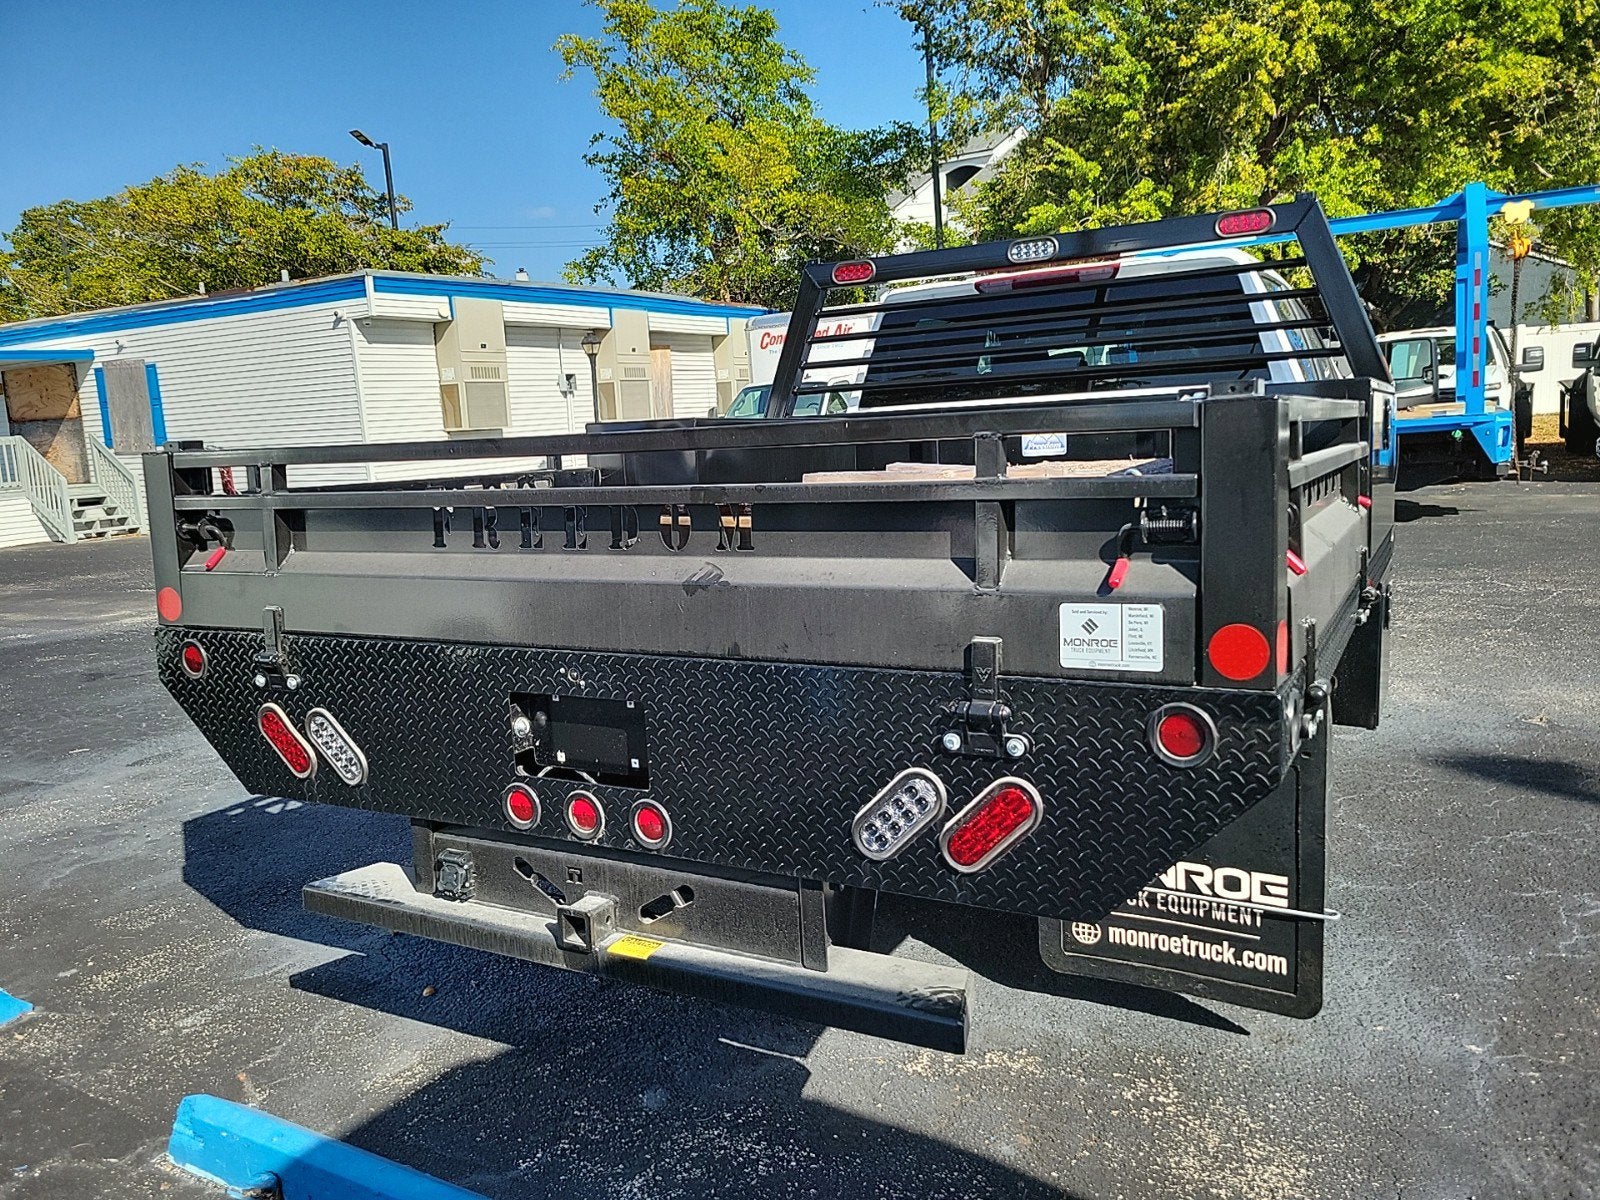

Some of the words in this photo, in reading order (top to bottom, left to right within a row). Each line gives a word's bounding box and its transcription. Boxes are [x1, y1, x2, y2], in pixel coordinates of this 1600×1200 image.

[834, 322, 853, 336] Air
[432, 500, 755, 552] FREEDOM
[1063, 637, 1118, 648] MONROE
[1157, 861, 1289, 908] NROE
[1156, 891, 1265, 928] EQUIPMENT
[1108, 925, 1289, 976] monroetruck.com
